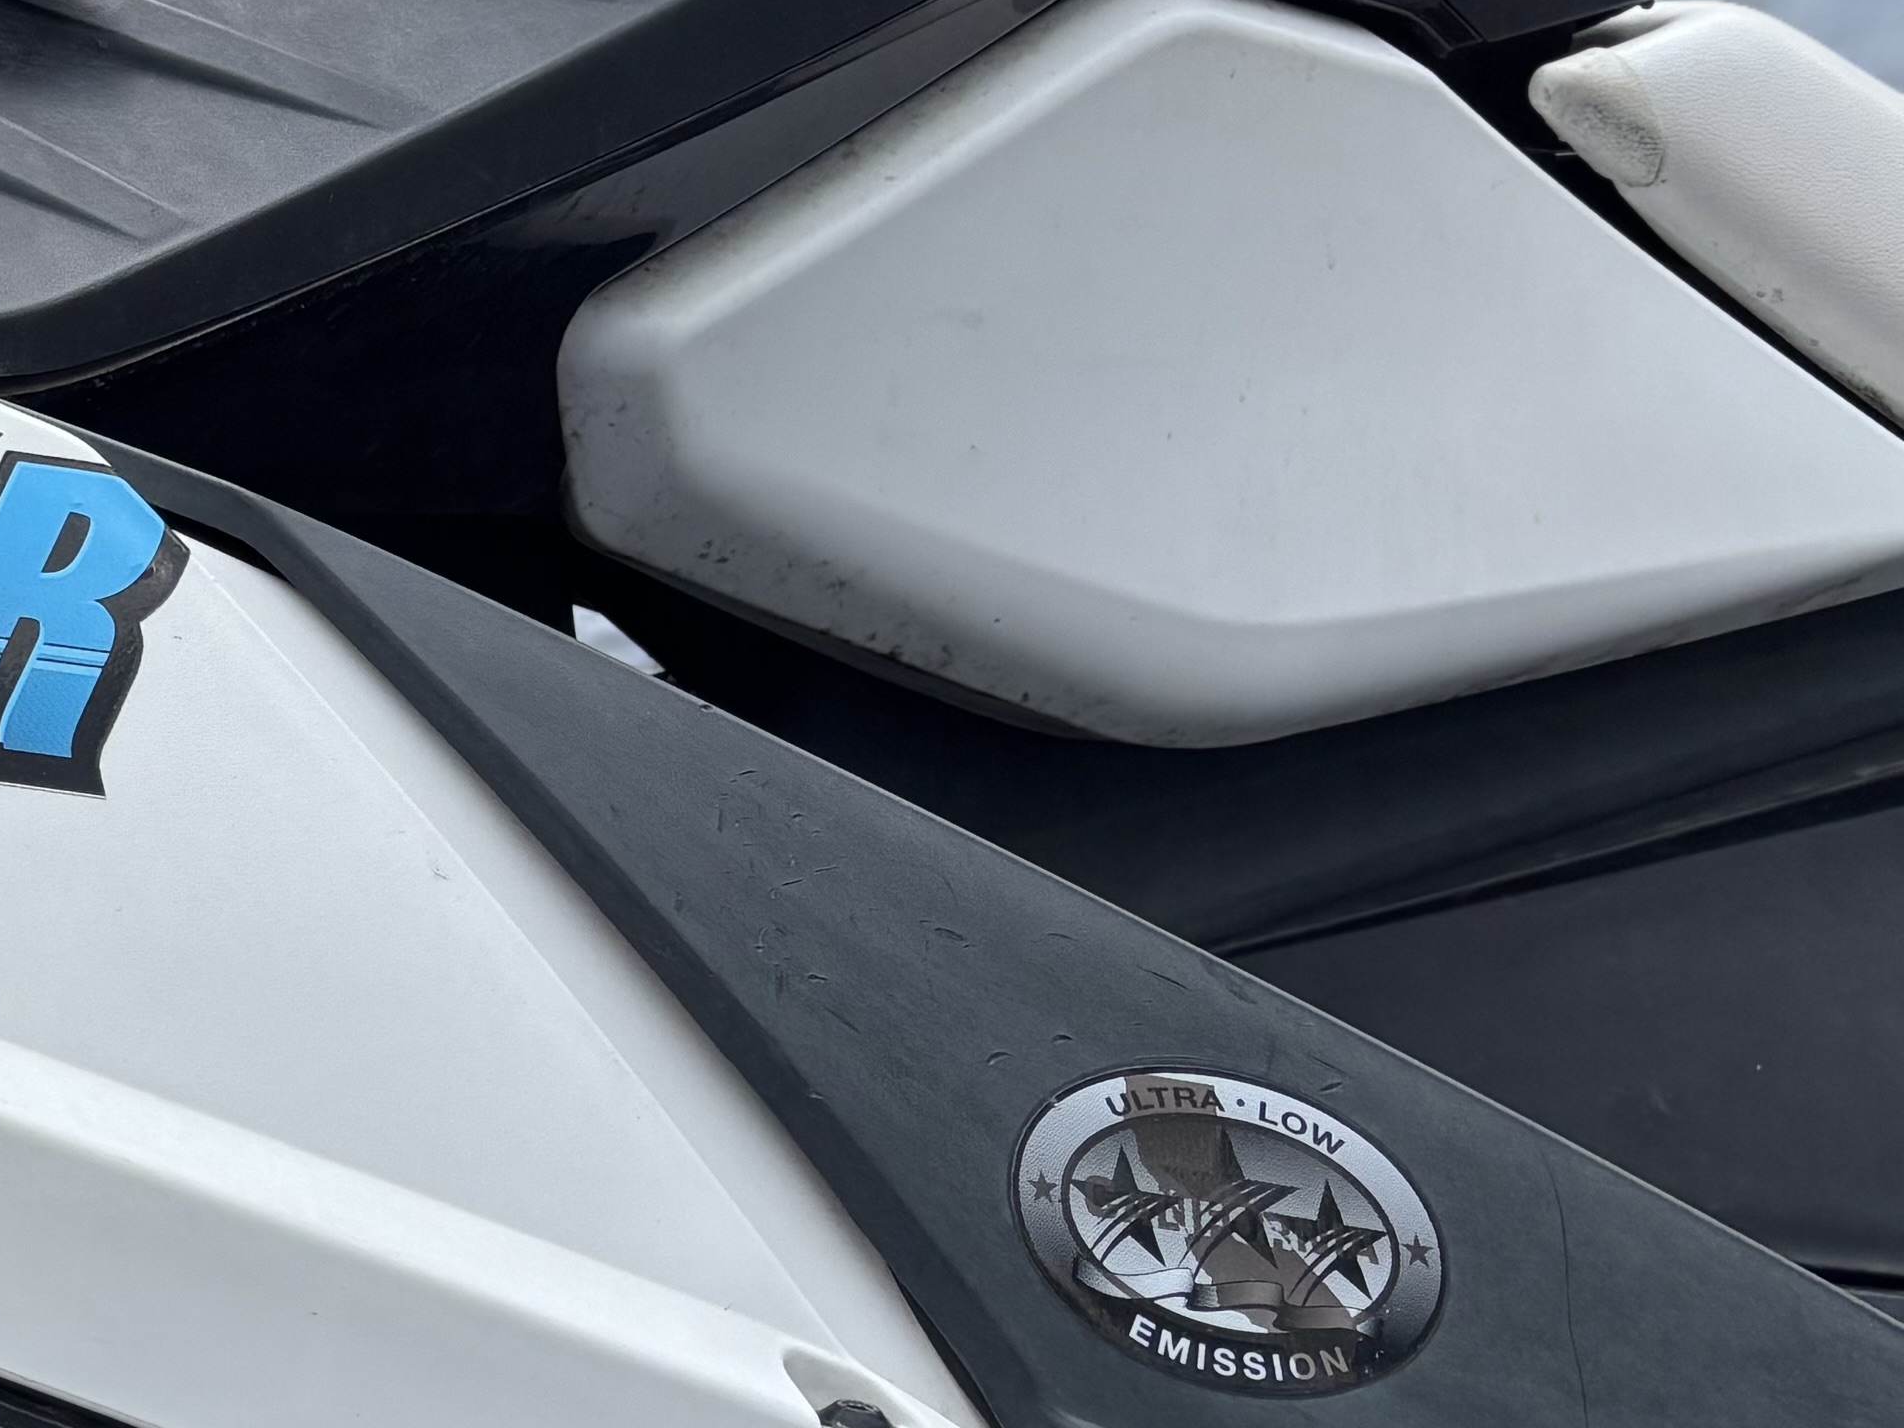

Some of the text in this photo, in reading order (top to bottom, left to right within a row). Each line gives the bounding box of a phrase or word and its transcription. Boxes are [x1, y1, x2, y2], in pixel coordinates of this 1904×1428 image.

[1104, 1086, 1347, 1156] ULTRA LOW
[1127, 1313, 1351, 1382] EMISSION
